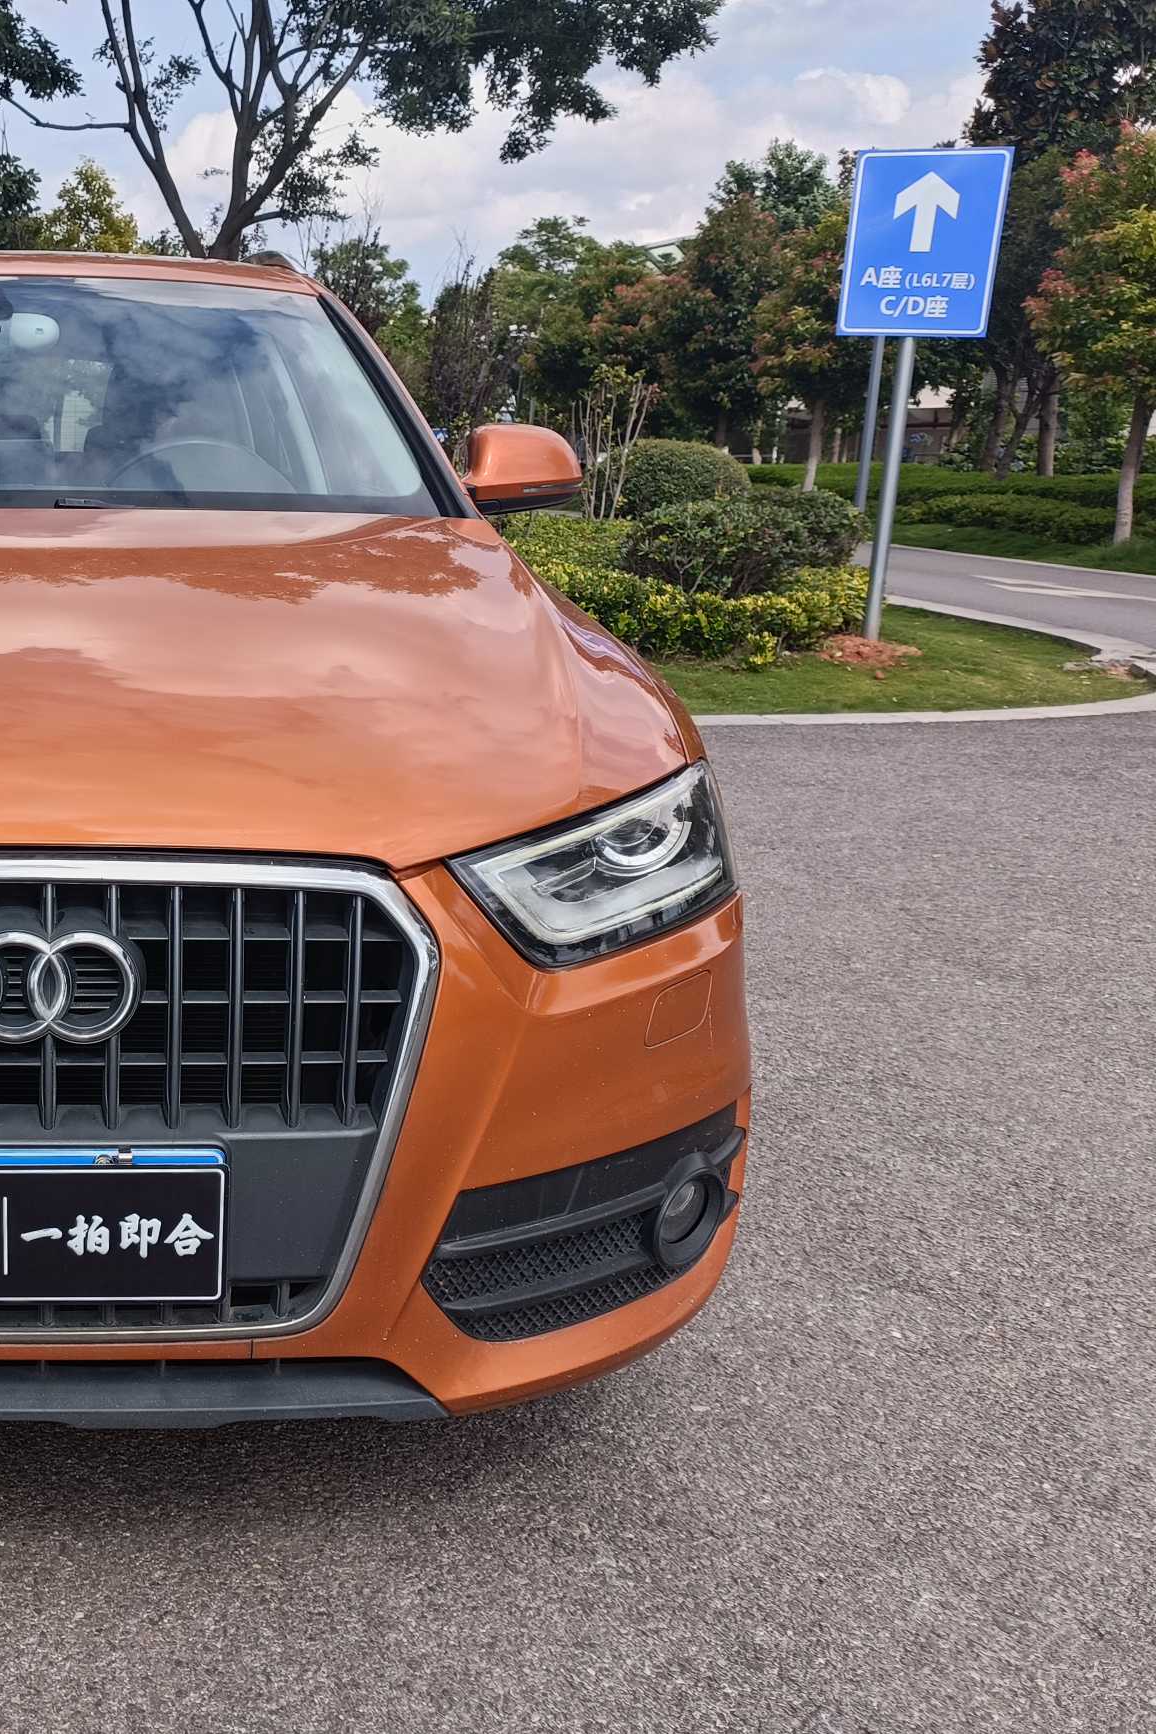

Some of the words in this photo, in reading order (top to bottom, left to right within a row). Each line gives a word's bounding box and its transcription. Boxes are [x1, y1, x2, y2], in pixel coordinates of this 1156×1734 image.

[860, 265, 903, 289] A座
[879, 295, 949, 318] C/D座
[20, 1213, 214, 1259] 一拍即合
